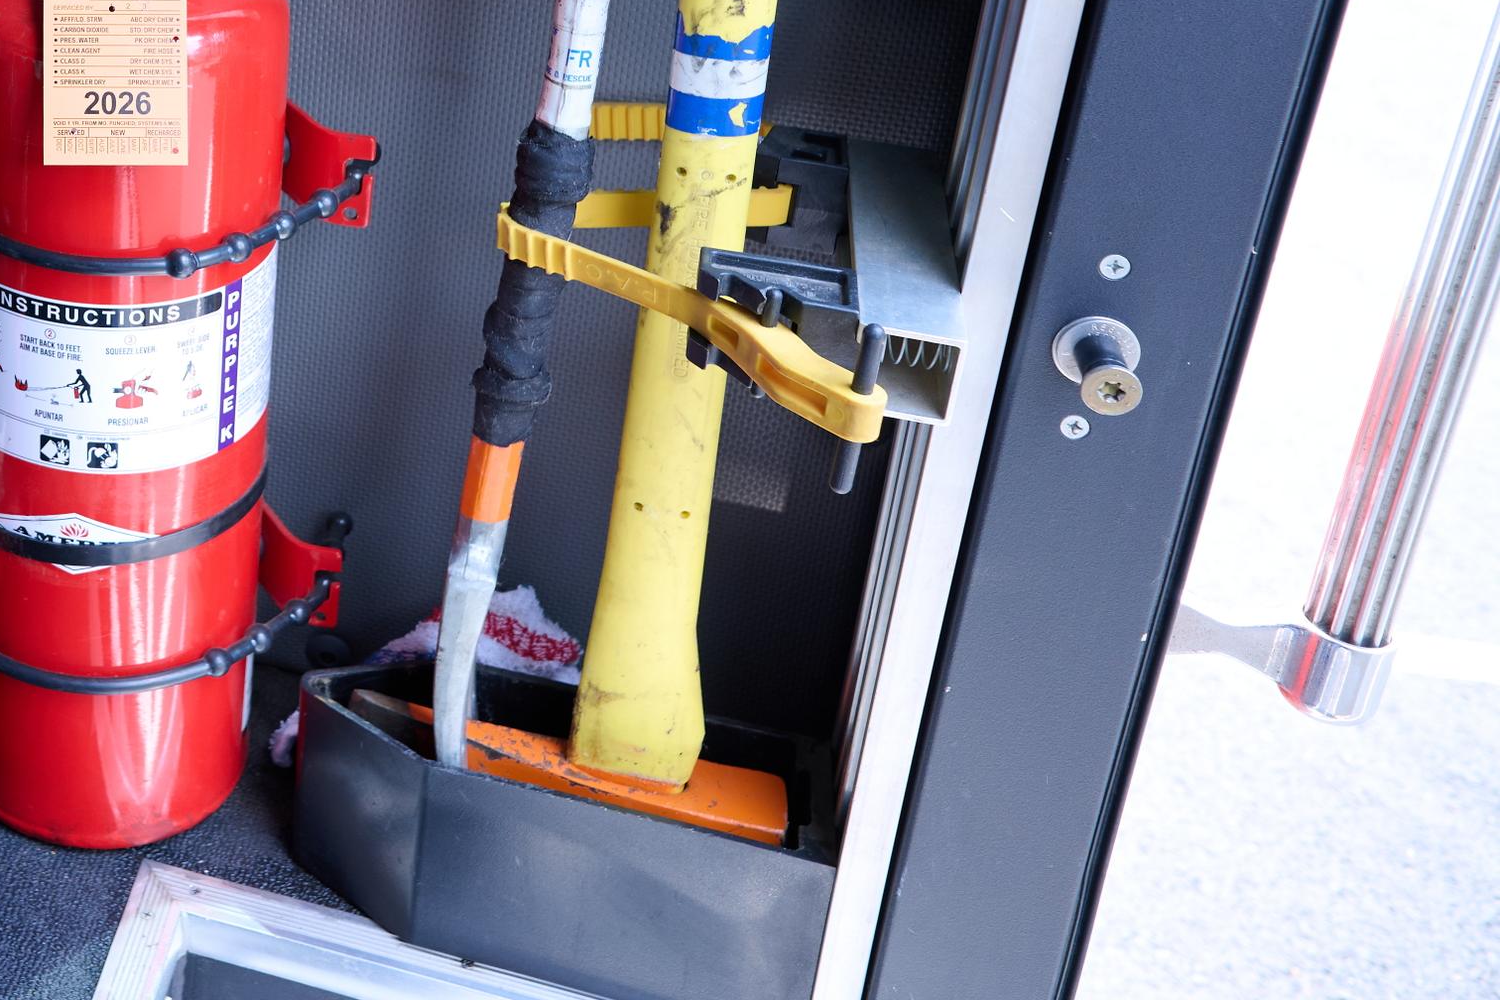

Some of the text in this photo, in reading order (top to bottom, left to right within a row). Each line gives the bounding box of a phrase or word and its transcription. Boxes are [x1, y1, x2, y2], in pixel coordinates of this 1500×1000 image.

[563, 74, 592, 82] RESCUE
[83, 91, 152, 115] 2026
[690, 196, 715, 232] FIRE
[20, 334, 38, 345] START
[39, 338, 55, 349] BACK
[57, 343, 64, 351] 10
[105, 346, 156, 356] SQUEEZE LEVER
[19, 342, 84, 362] AIM AT BASE OF FIRE.
[220, 291, 240, 444] PURPLE K
[35, 409, 64, 422] APUNTAR
[107, 417, 149, 426] PRESIONAR
